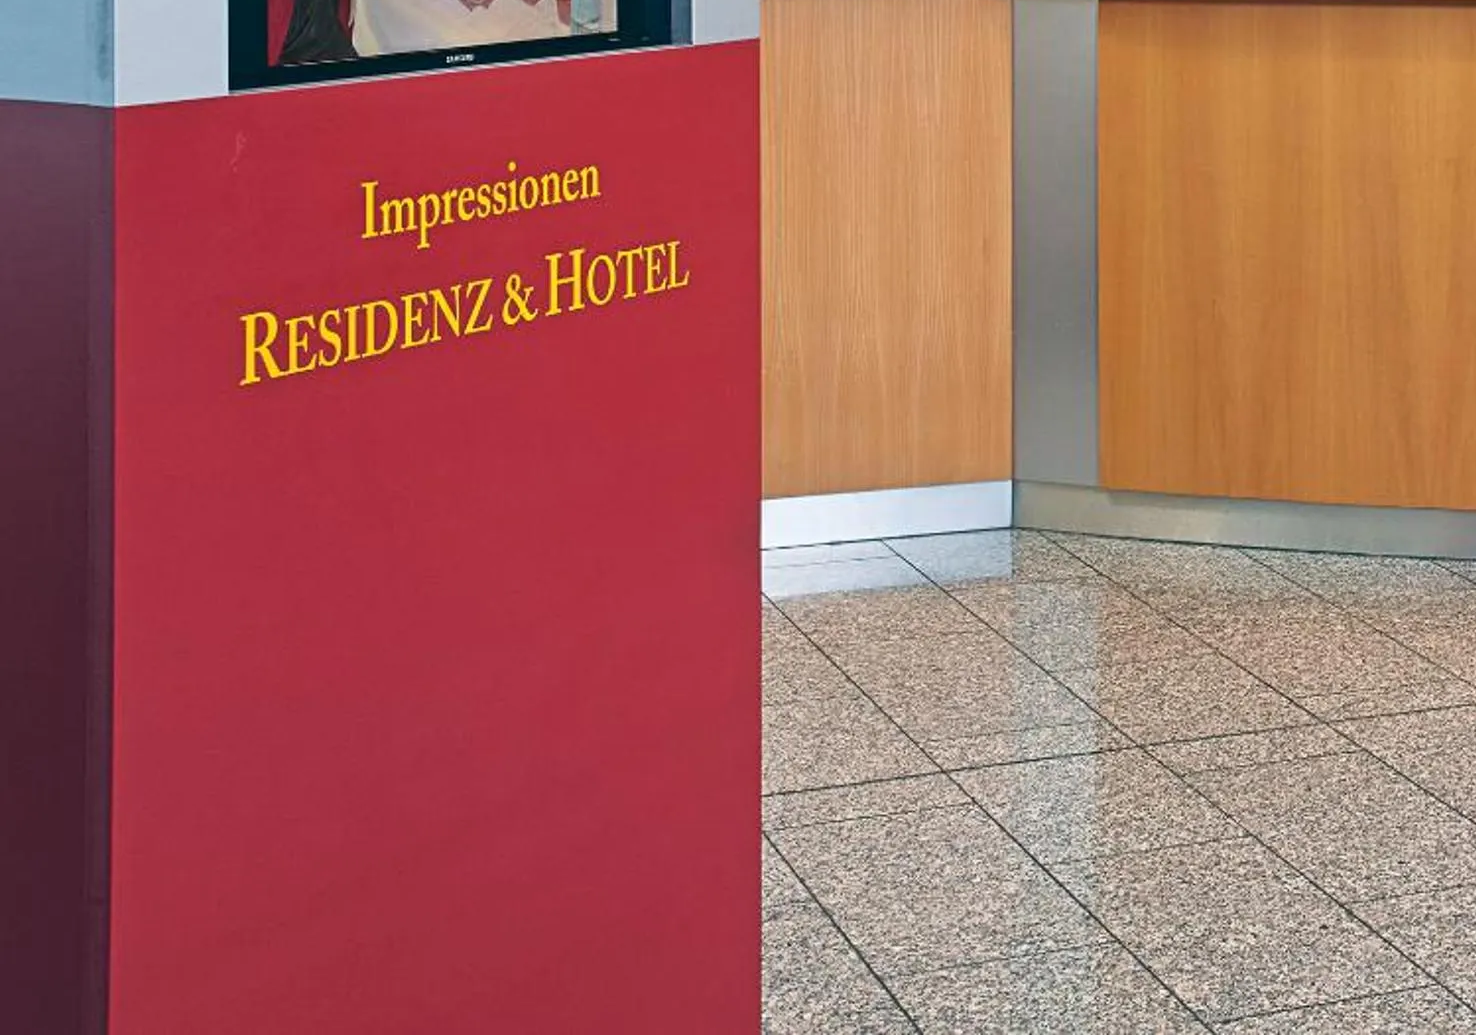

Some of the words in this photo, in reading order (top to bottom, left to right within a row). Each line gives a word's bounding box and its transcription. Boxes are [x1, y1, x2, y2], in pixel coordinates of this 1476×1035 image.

[361, 161, 601, 249] Impressionen
[239, 278, 494, 386] RESIDENZ
[502, 273, 538, 325] &
[545, 240, 690, 317] HOTEL
